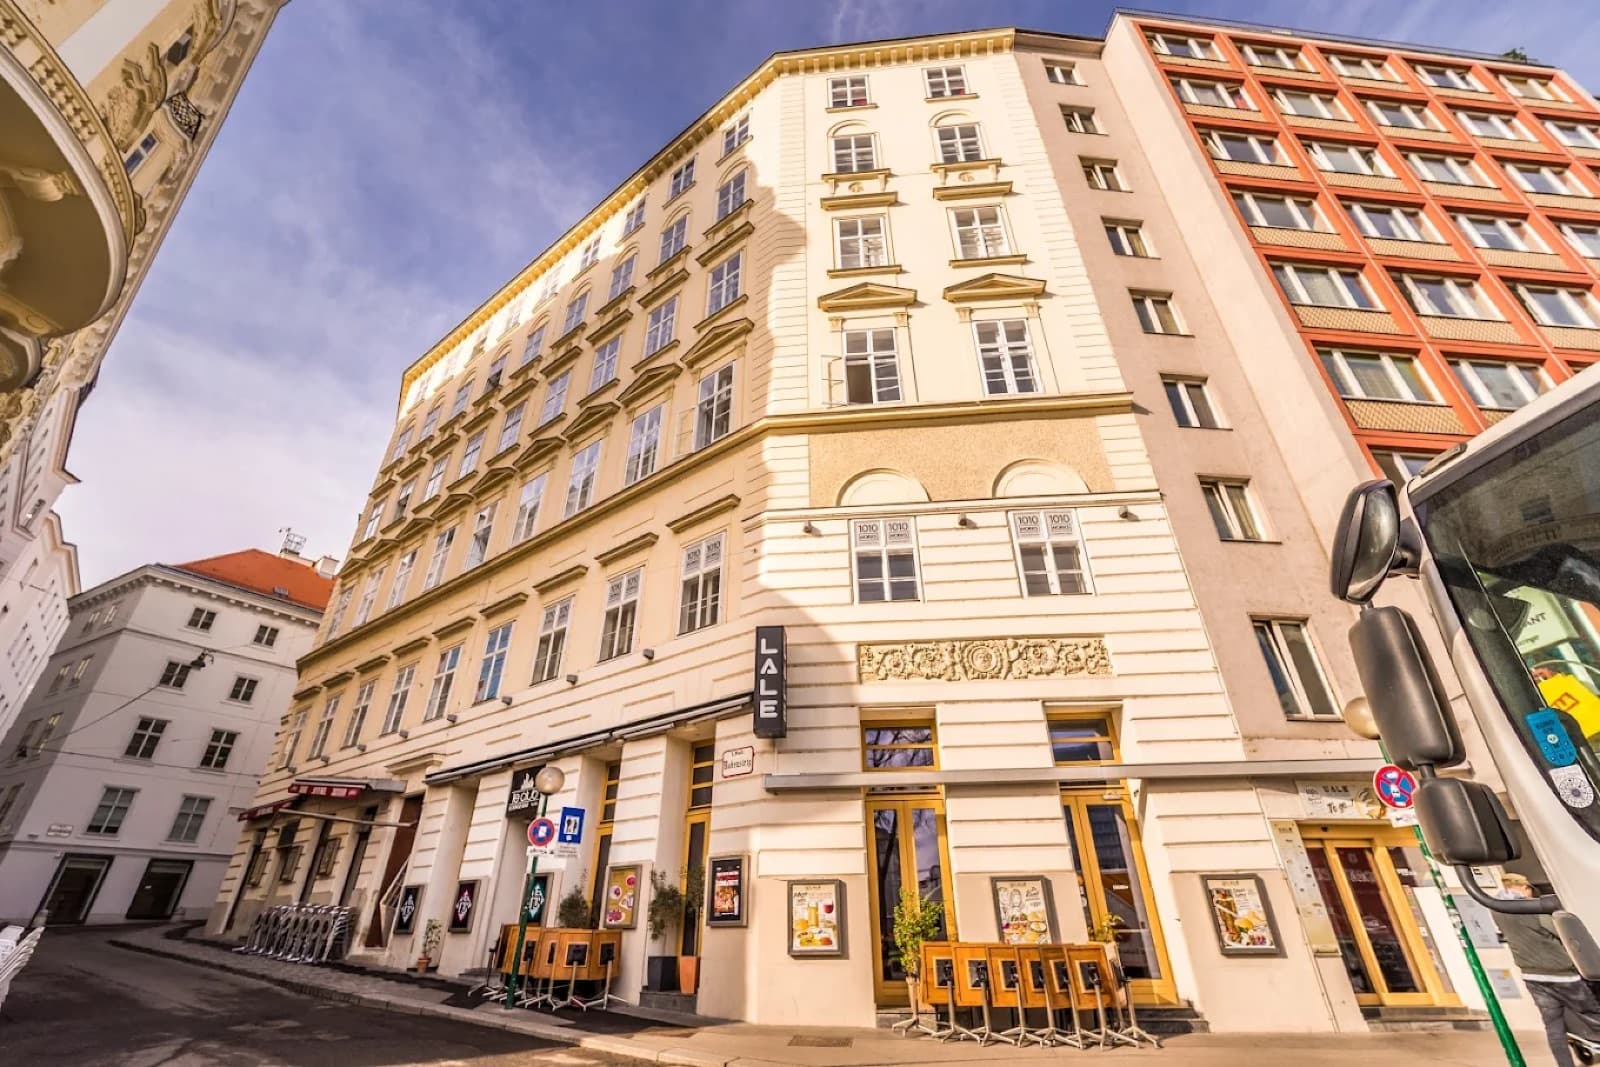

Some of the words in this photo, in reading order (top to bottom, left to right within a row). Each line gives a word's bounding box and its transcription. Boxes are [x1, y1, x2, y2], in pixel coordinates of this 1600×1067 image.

[1018, 515, 1039, 525] 1010
[1049, 514, 1070, 523] 1010
[858, 524, 879, 533] 1010
[888, 522, 909, 531] 1010
[760, 638, 779, 719] LALE
